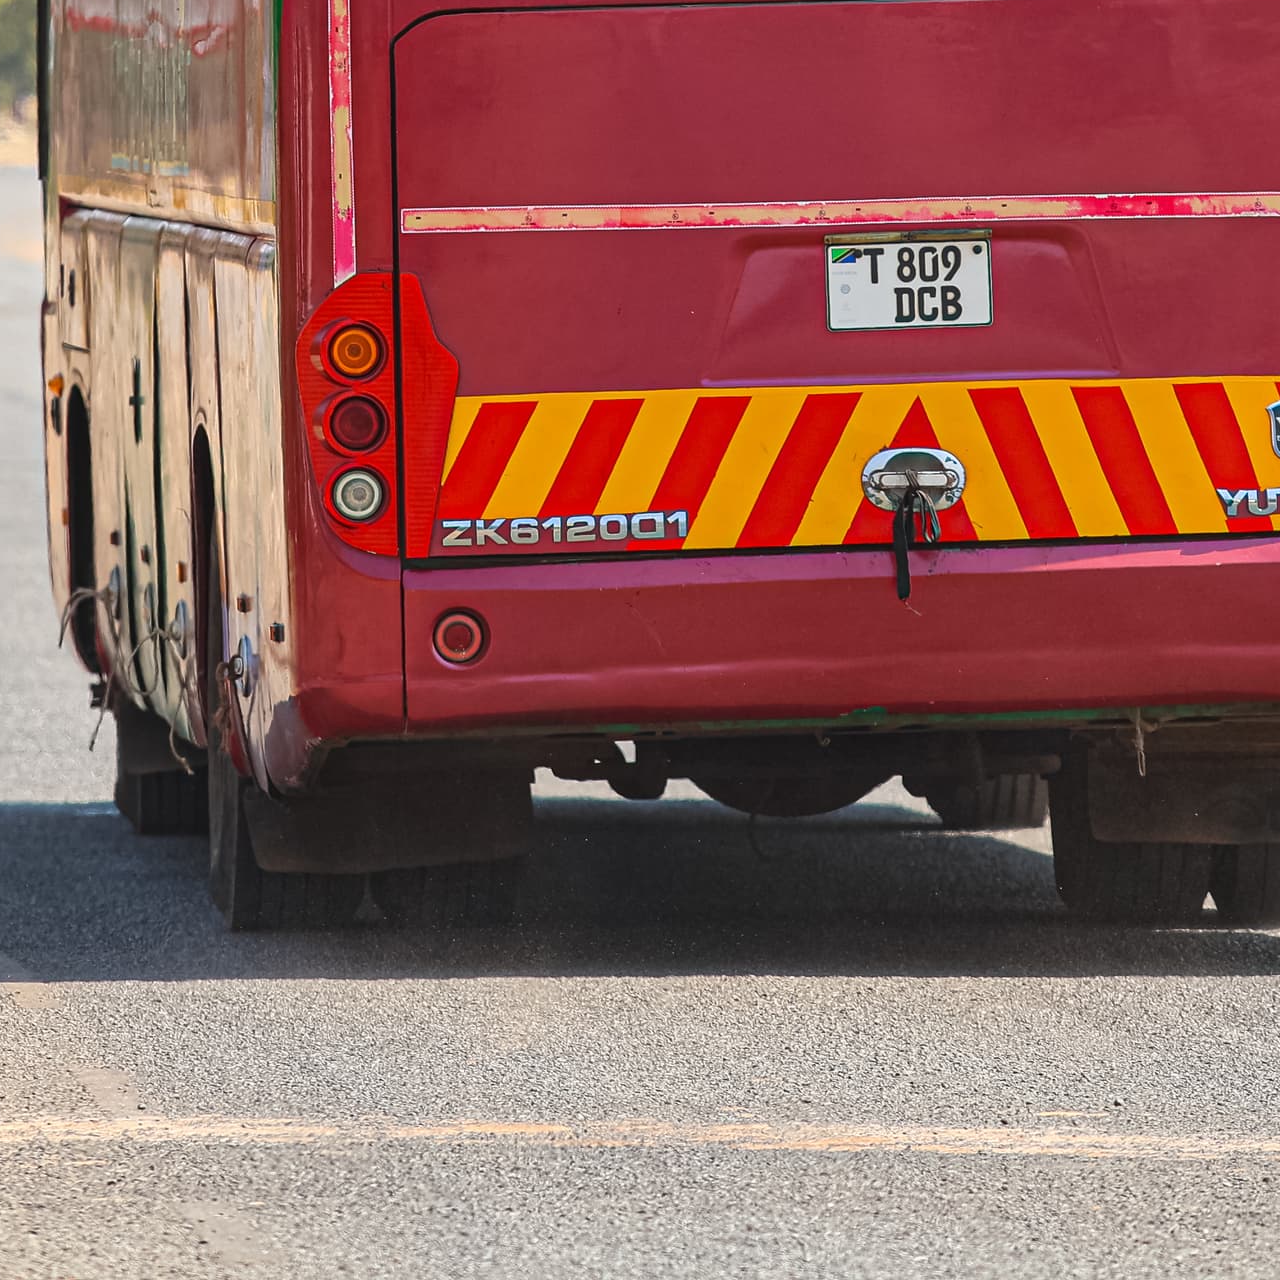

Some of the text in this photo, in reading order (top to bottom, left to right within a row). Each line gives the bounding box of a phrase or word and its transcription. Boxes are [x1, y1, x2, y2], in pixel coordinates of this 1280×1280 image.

[863, 245, 962, 284] T 809
[894, 285, 963, 323] DCB
